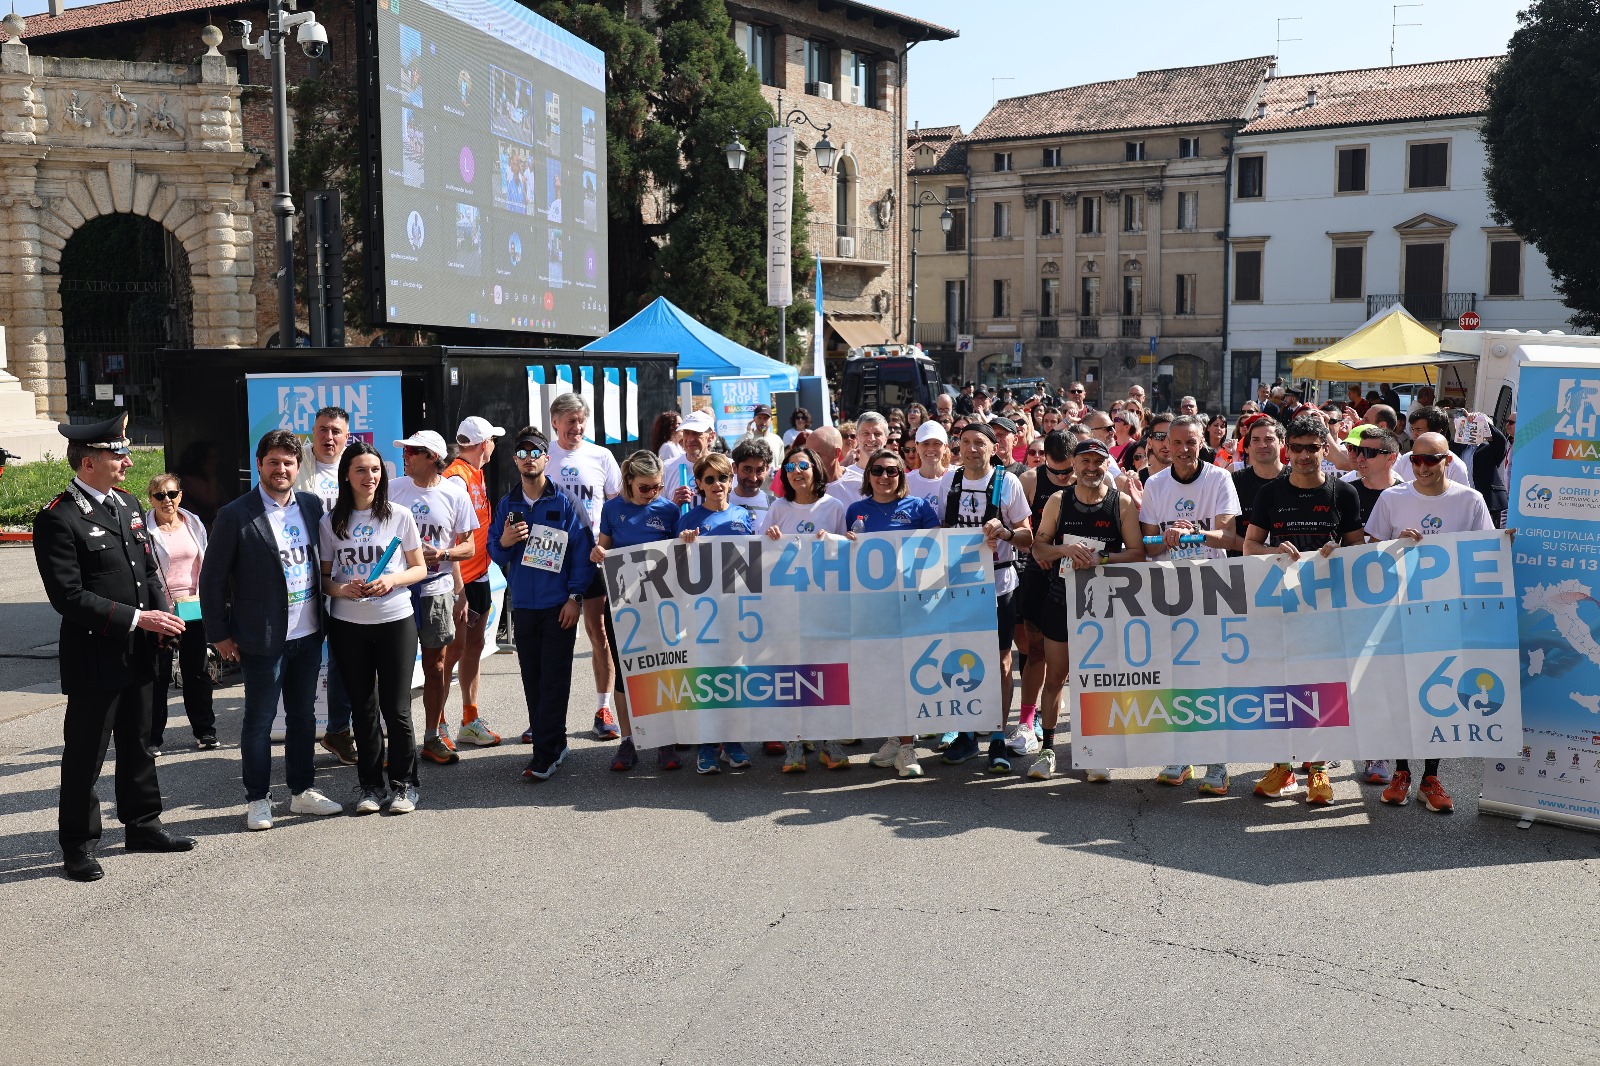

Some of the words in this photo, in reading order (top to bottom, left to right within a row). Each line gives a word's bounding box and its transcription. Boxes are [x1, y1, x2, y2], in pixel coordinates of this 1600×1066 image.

[769, 133, 788, 273] TEATRALITÀ
[1460, 317, 1479, 326] STOP
[278, 411, 369, 432] 4HE
[1525, 484, 1552, 501] 60
[1559, 486, 1590, 496] CORRI
[1175, 498, 1195, 511] 60
[1527, 502, 1550, 510] AIRC
[796, 519, 815, 533] 60
[1421, 513, 1442, 528] 60
[353, 523, 373, 538] 60
[1525, 528, 1551, 538] GIRO
[1553, 530, 1595, 541] D'ITALIA
[528, 535, 564, 554] RUN
[1542, 541, 1557, 551] SU
[1559, 542, 1600, 554] STAFFE
[1515, 552, 1542, 566] Dal
[1547, 556, 1557, 567] 5
[1561, 558, 1575, 569] al
[1579, 559, 1598, 571] 13
[903, 587, 986, 602] ITALIA
[1408, 601, 1504, 616] ITALIA
[614, 595, 764, 656] 2025
[1077, 617, 1250, 670] 2025
[623, 659, 633, 672] V
[638, 650, 688, 670] EDIZIONE
[909, 639, 985, 696] 60
[1079, 674, 1089, 688] V
[1094, 671, 1161, 688] EDIZIONE
[1418, 655, 1505, 718] 60
[916, 699, 983, 719] AIRC
[1428, 724, 1503, 743] AIRC
